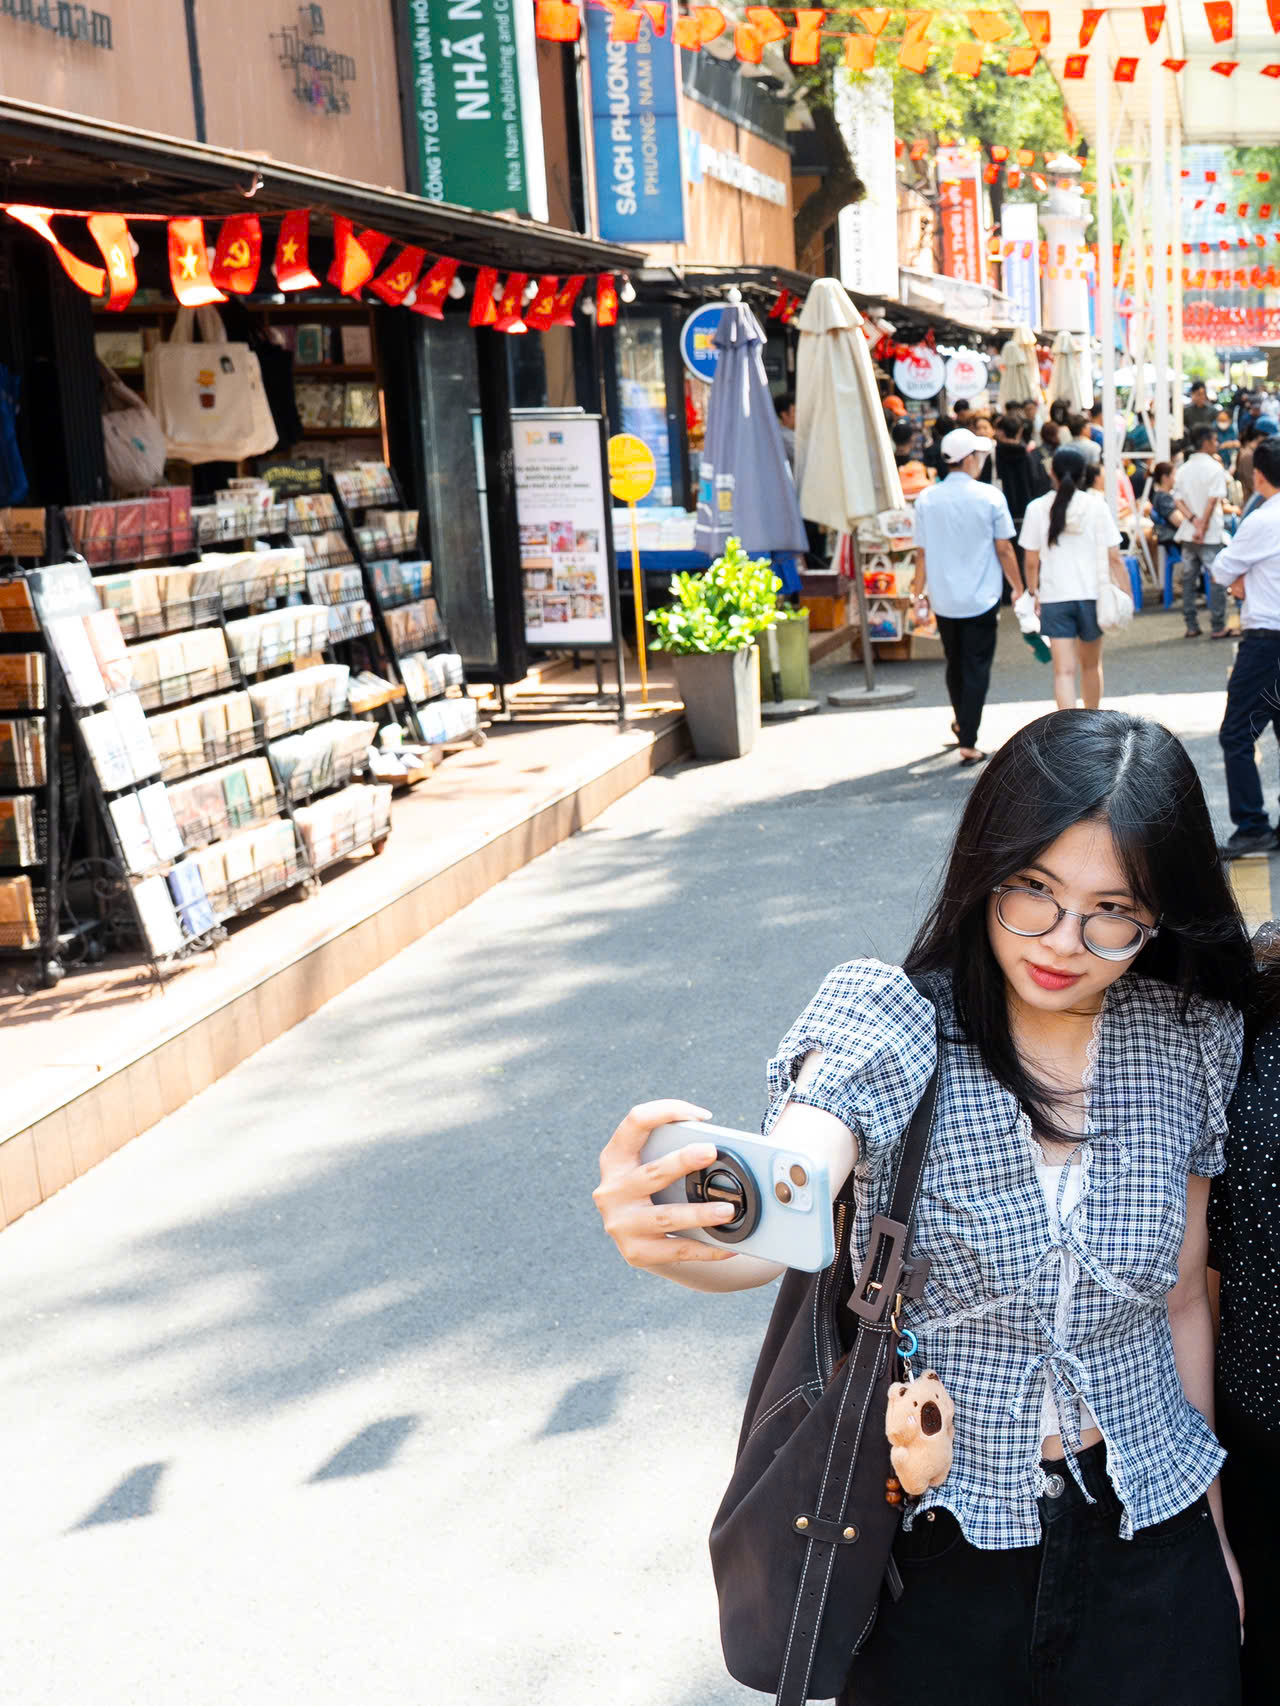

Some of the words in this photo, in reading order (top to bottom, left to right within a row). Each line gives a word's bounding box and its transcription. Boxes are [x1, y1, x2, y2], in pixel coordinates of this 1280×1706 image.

[496, 11, 512, 42] and
[440, 32, 491, 120] NHÃ
[499, 44, 519, 120] Publishing
[605, 40, 632, 141] PHƯƠNG
[637, 59, 653, 106] NAM
[424, 135, 440, 155] TY
[504, 123, 520, 159] Nam
[639, 111, 659, 196] PHUONG
[507, 158, 522, 192] Nha
[611, 145, 637, 215] SÁCH
